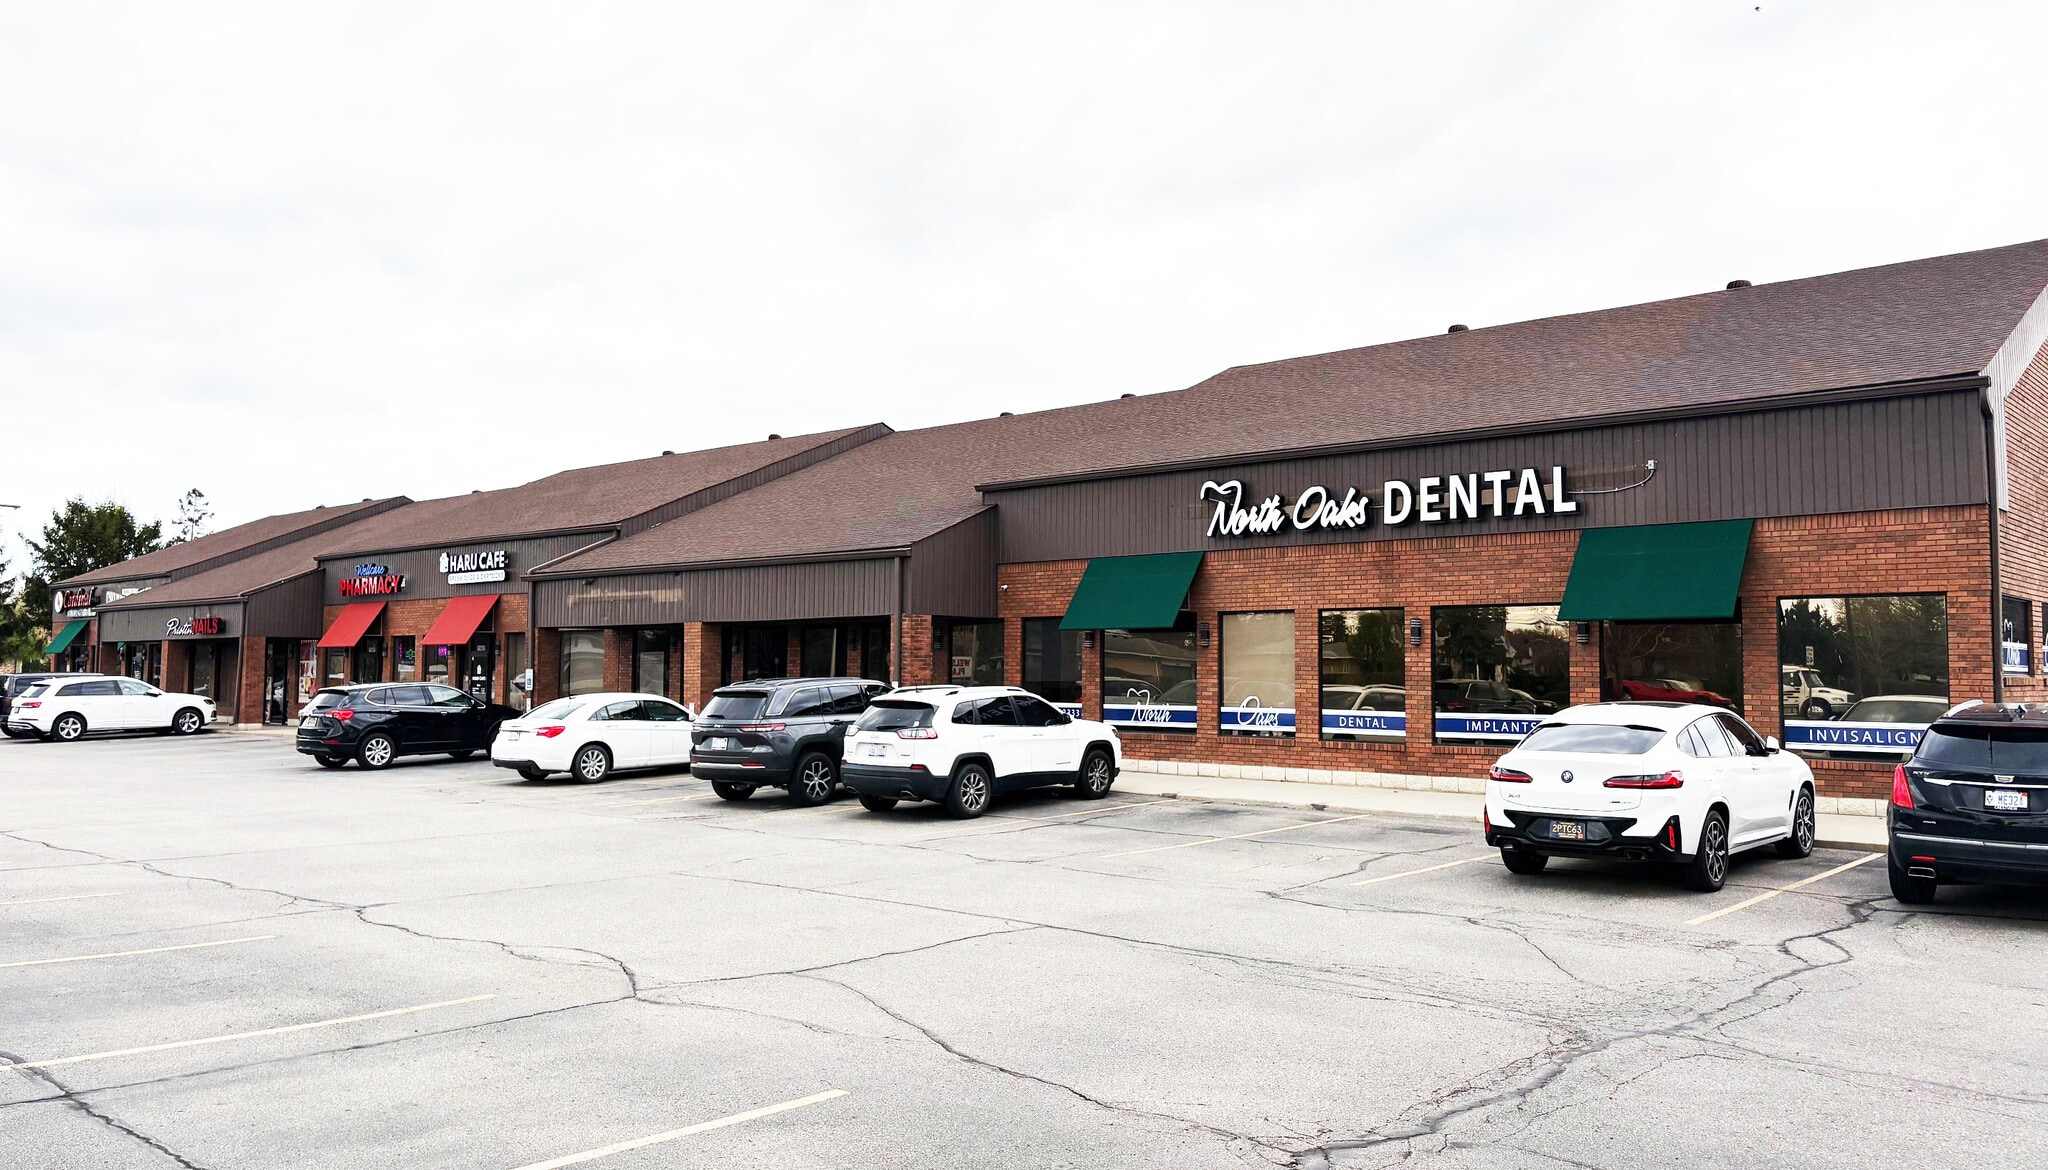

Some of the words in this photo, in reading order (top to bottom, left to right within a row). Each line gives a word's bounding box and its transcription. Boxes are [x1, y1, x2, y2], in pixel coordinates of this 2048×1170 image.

[1200, 480, 1285, 537] North
[1292, 485, 1369, 530] Oaks
[1383, 465, 1577, 525] DENTAL
[449, 553, 477, 572] HARU
[479, 550, 505, 569] CAFE
[339, 574, 401, 597] PHARMACY
[192, 618, 218, 635] NAILS
[1127, 688, 1171, 722] North
[1237, 695, 1279, 726] Oaks
[1339, 716, 1388, 729] DENTAL
[1466, 720, 1537, 733] IMPLANTS
[1809, 729, 1921, 744] INVISALIGN
[1552, 823, 1582, 834] 2PTC63
